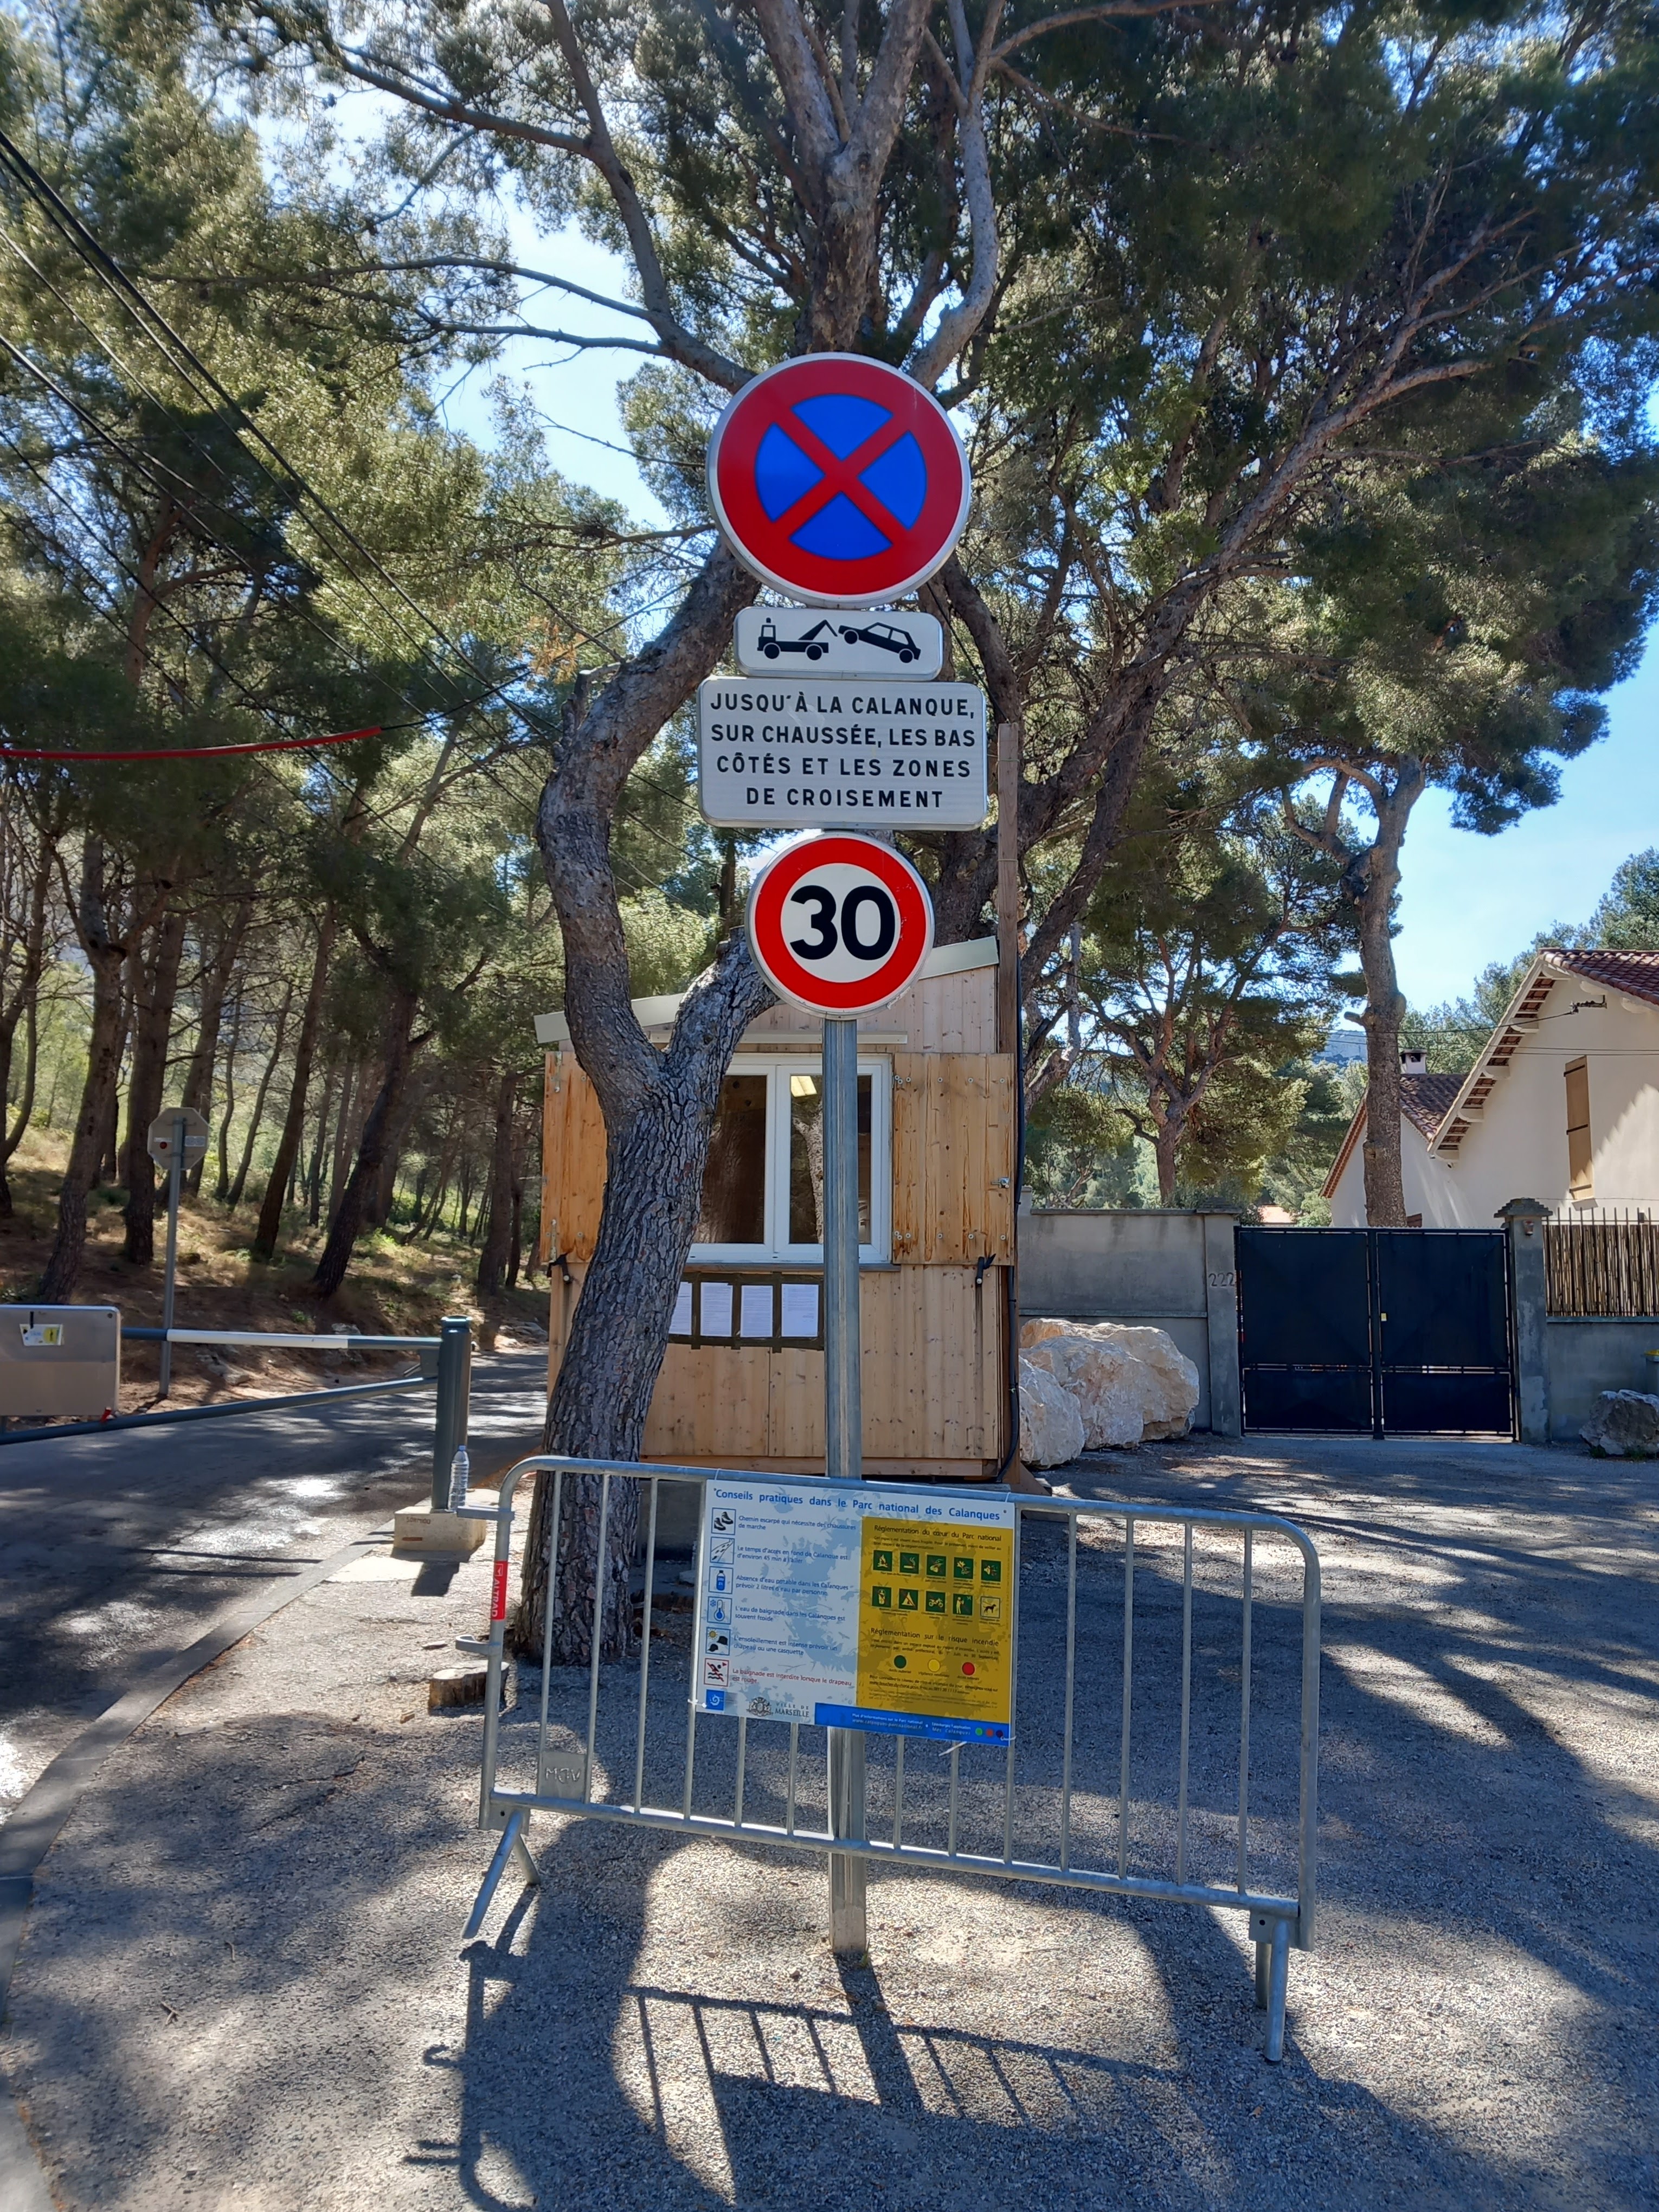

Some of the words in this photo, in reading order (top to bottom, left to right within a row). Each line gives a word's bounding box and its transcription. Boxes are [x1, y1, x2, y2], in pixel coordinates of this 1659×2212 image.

[818, 696, 842, 713] LA
[852, 697, 974, 718] CALANQUE,
[711, 724, 754, 742] SUR
[762, 724, 882, 748] CHAUSSÉE,
[889, 729, 927, 746] LES
[935, 730, 975, 747] BAS
[717, 752, 790, 774] CÔTÉS
[802, 758, 828, 774] ET
[840, 758, 881, 776] LES
[893, 760, 970, 777] ZONES
[747, 787, 775, 805] DE
[787, 789, 942, 807] CROISEMENT
[790, 885, 895, 960] 30
[1208, 1272, 1235, 1287] 222
[716, 1490, 753, 1500] Conseils
[759, 1493, 803, 1504] pratiques
[809, 1496, 831, 1506] dans
[838, 1498, 846, 1507] le
[853, 1500, 872, 1509] Parc
[879, 1503, 918, 1513] national
[925, 1506, 942, 1515] des
[949, 1508, 1000, 1521] Calanques
[492, 1578, 500, 1617] ALTRAD
[949, 1636, 967, 1644] risque
[972, 1638, 999, 1646] incendie
[801, 1675, 820, 1683] lorsque
[828, 1678, 851, 1686] drapeau
[775, 1708, 809, 1718] MARSEILLE
